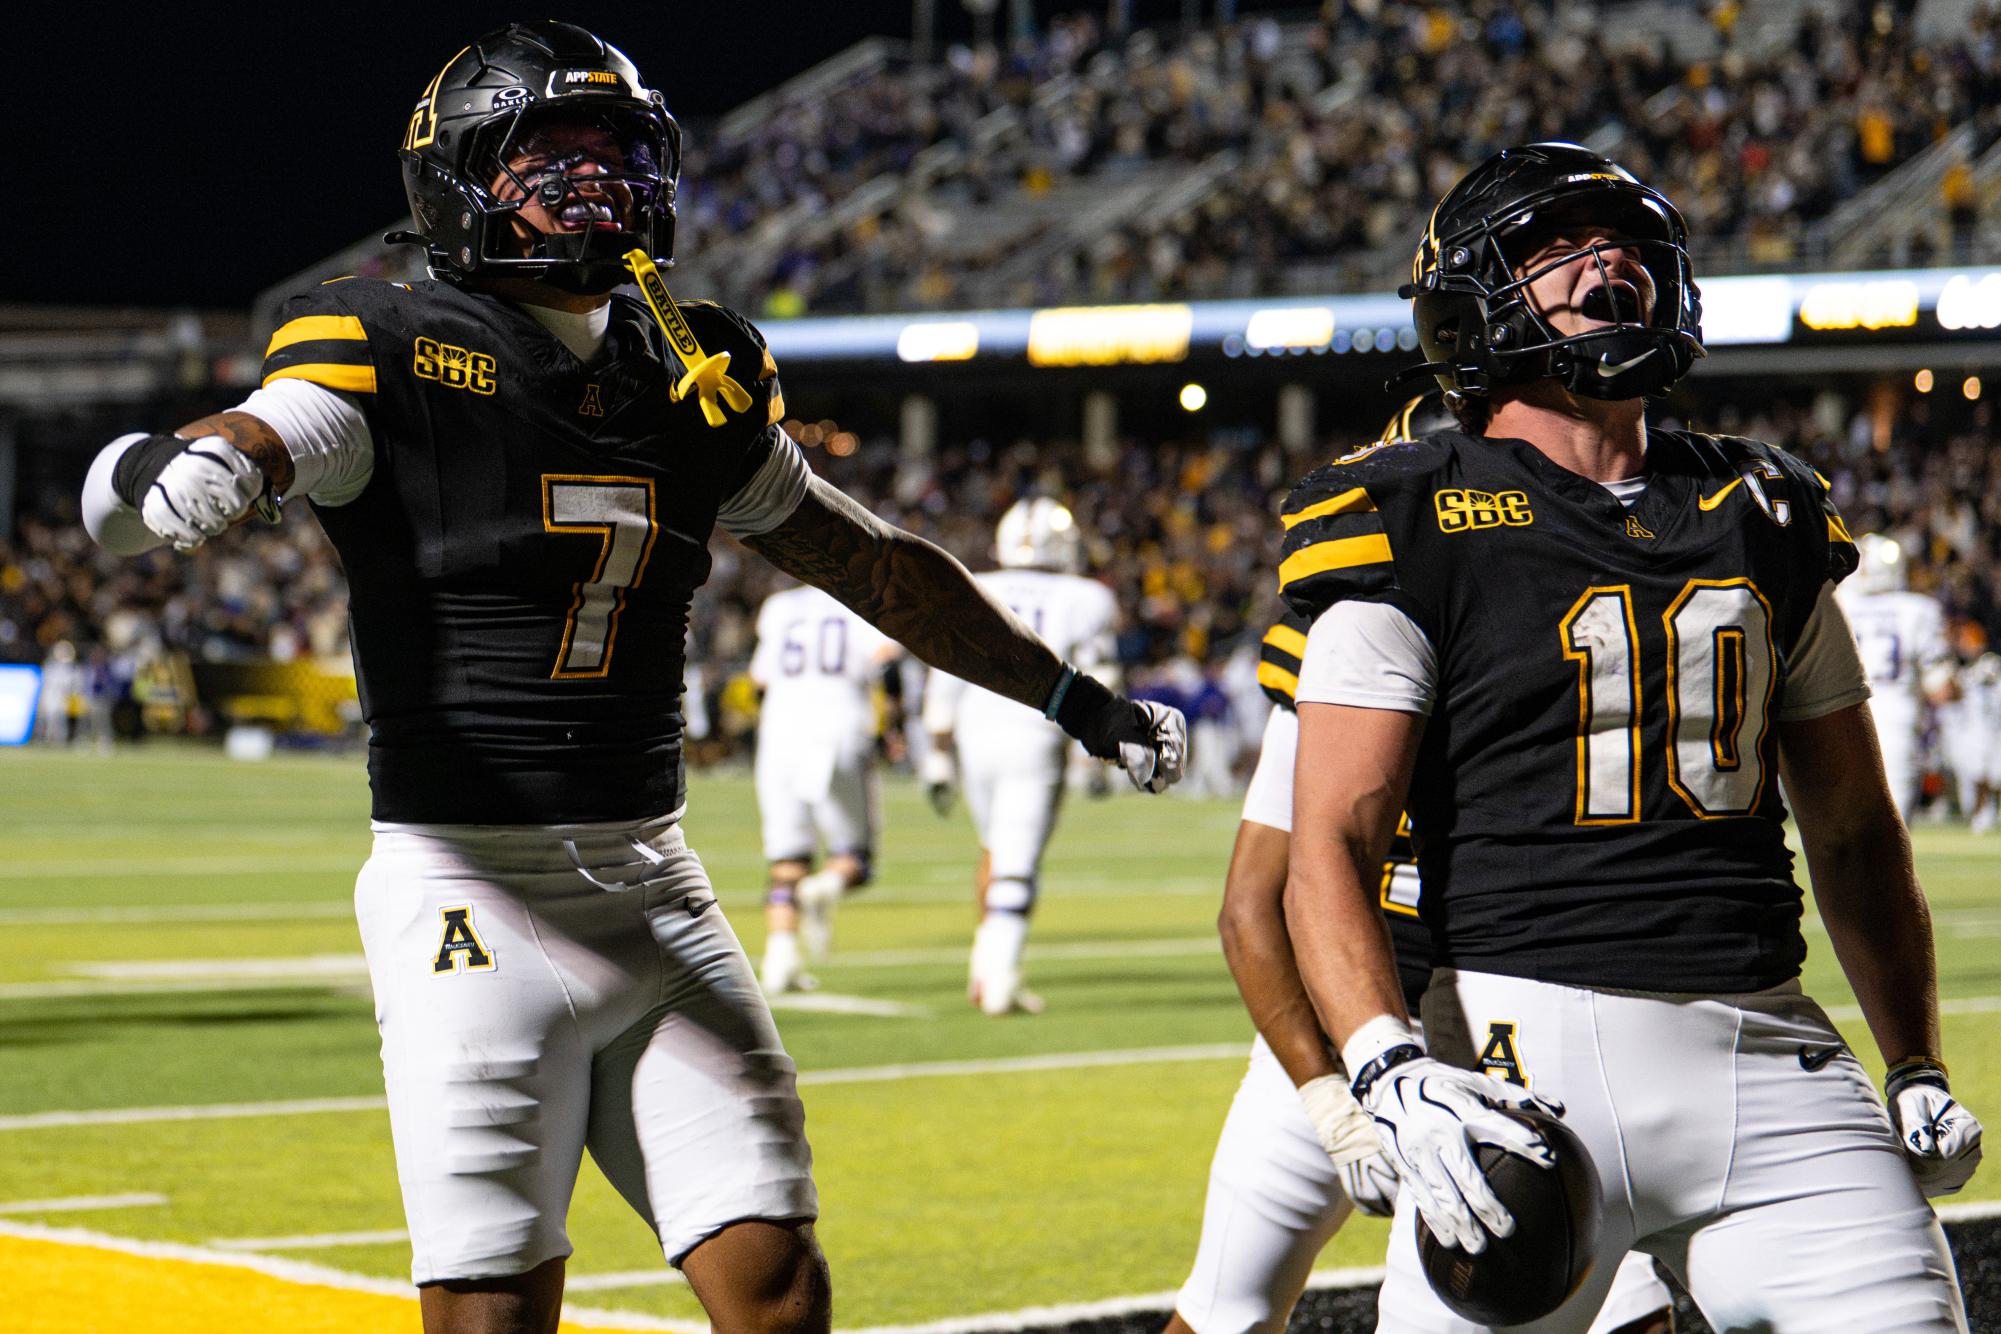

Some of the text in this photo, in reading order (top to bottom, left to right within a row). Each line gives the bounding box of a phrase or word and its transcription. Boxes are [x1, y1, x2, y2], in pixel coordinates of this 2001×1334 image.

[493, 96, 535, 109] OAKLEY
[565, 71, 617, 84] APPSTATE
[648, 281, 692, 350] BATTLE
[414, 336, 496, 395] SBC
[579, 385, 603, 416] A
[1434, 489, 1534, 533] SBC
[541, 473, 658, 679] 7
[782, 616, 847, 677] 60
[1560, 577, 1777, 826] 10
[433, 906, 493, 974] A
[1474, 1018, 1529, 1090] A
